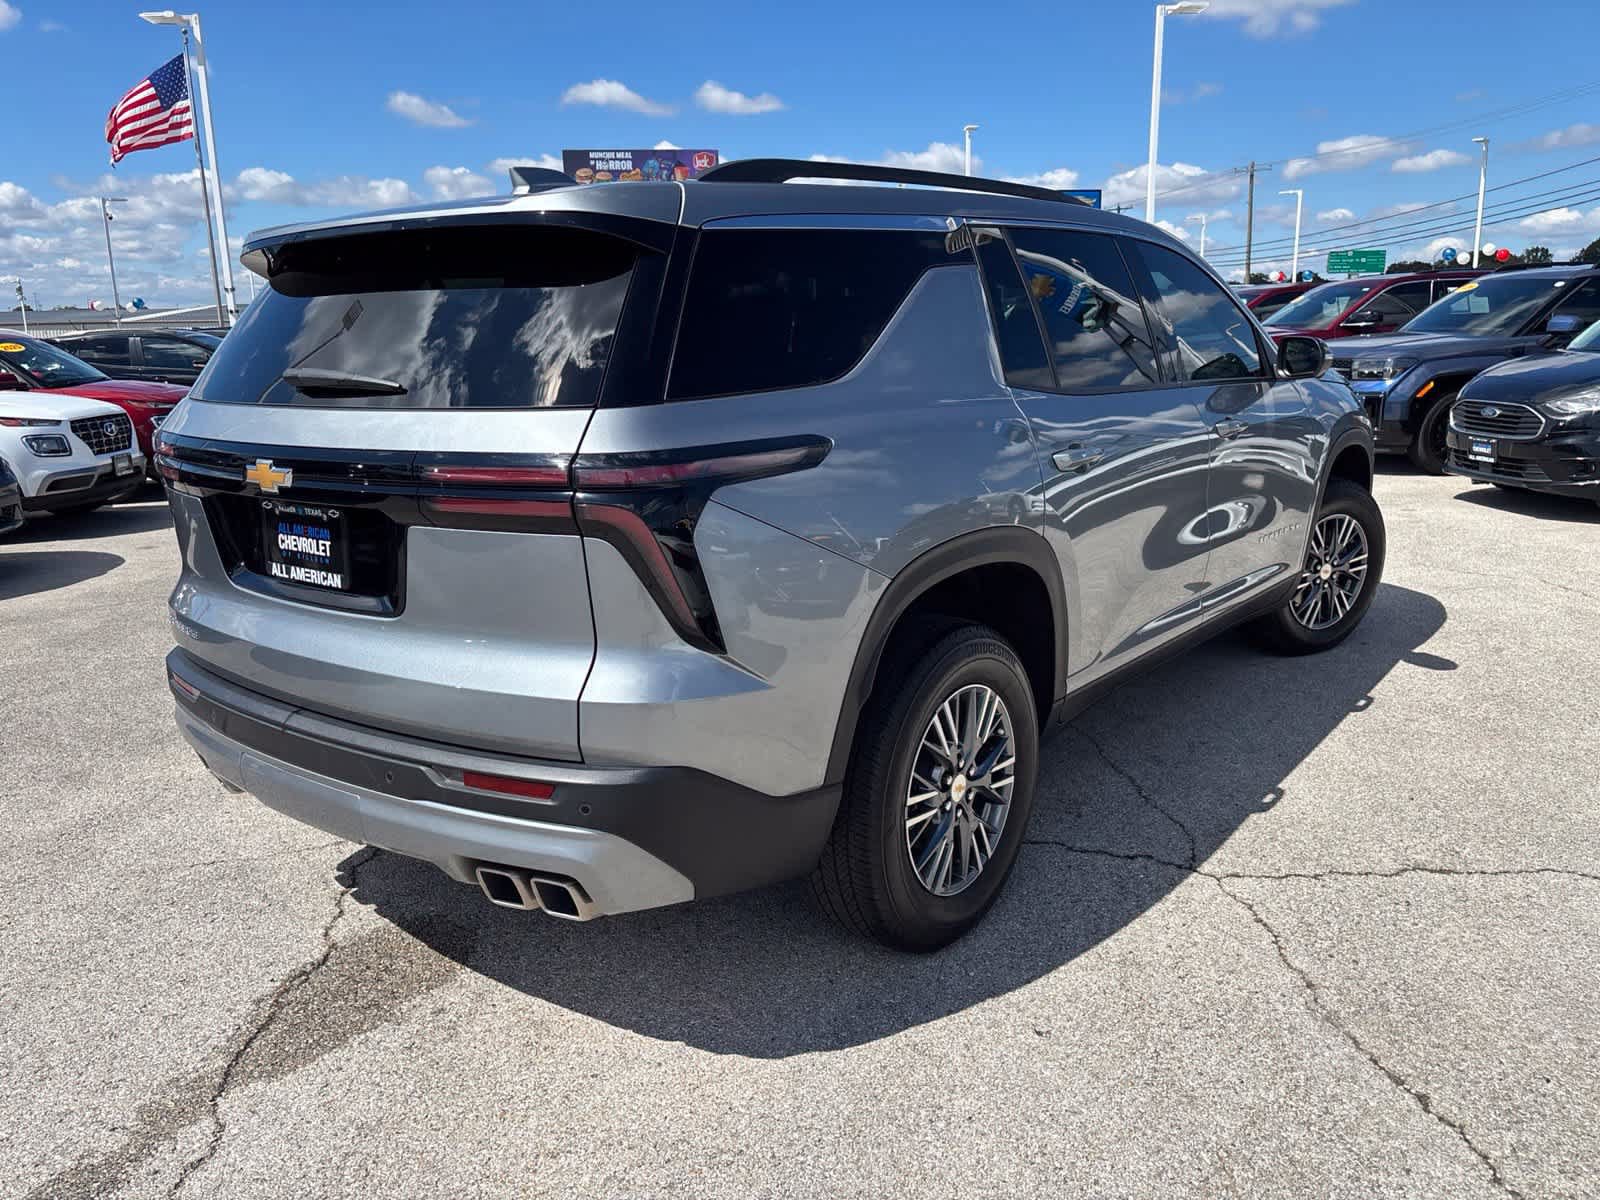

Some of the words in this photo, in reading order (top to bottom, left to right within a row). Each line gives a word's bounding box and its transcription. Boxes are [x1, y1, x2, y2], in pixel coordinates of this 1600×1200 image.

[278, 522, 291, 533] ALL
[278, 533, 331, 557] CHEVROLET
[271, 562, 289, 578] ALL
[290, 565, 342, 588] AMERICAN
